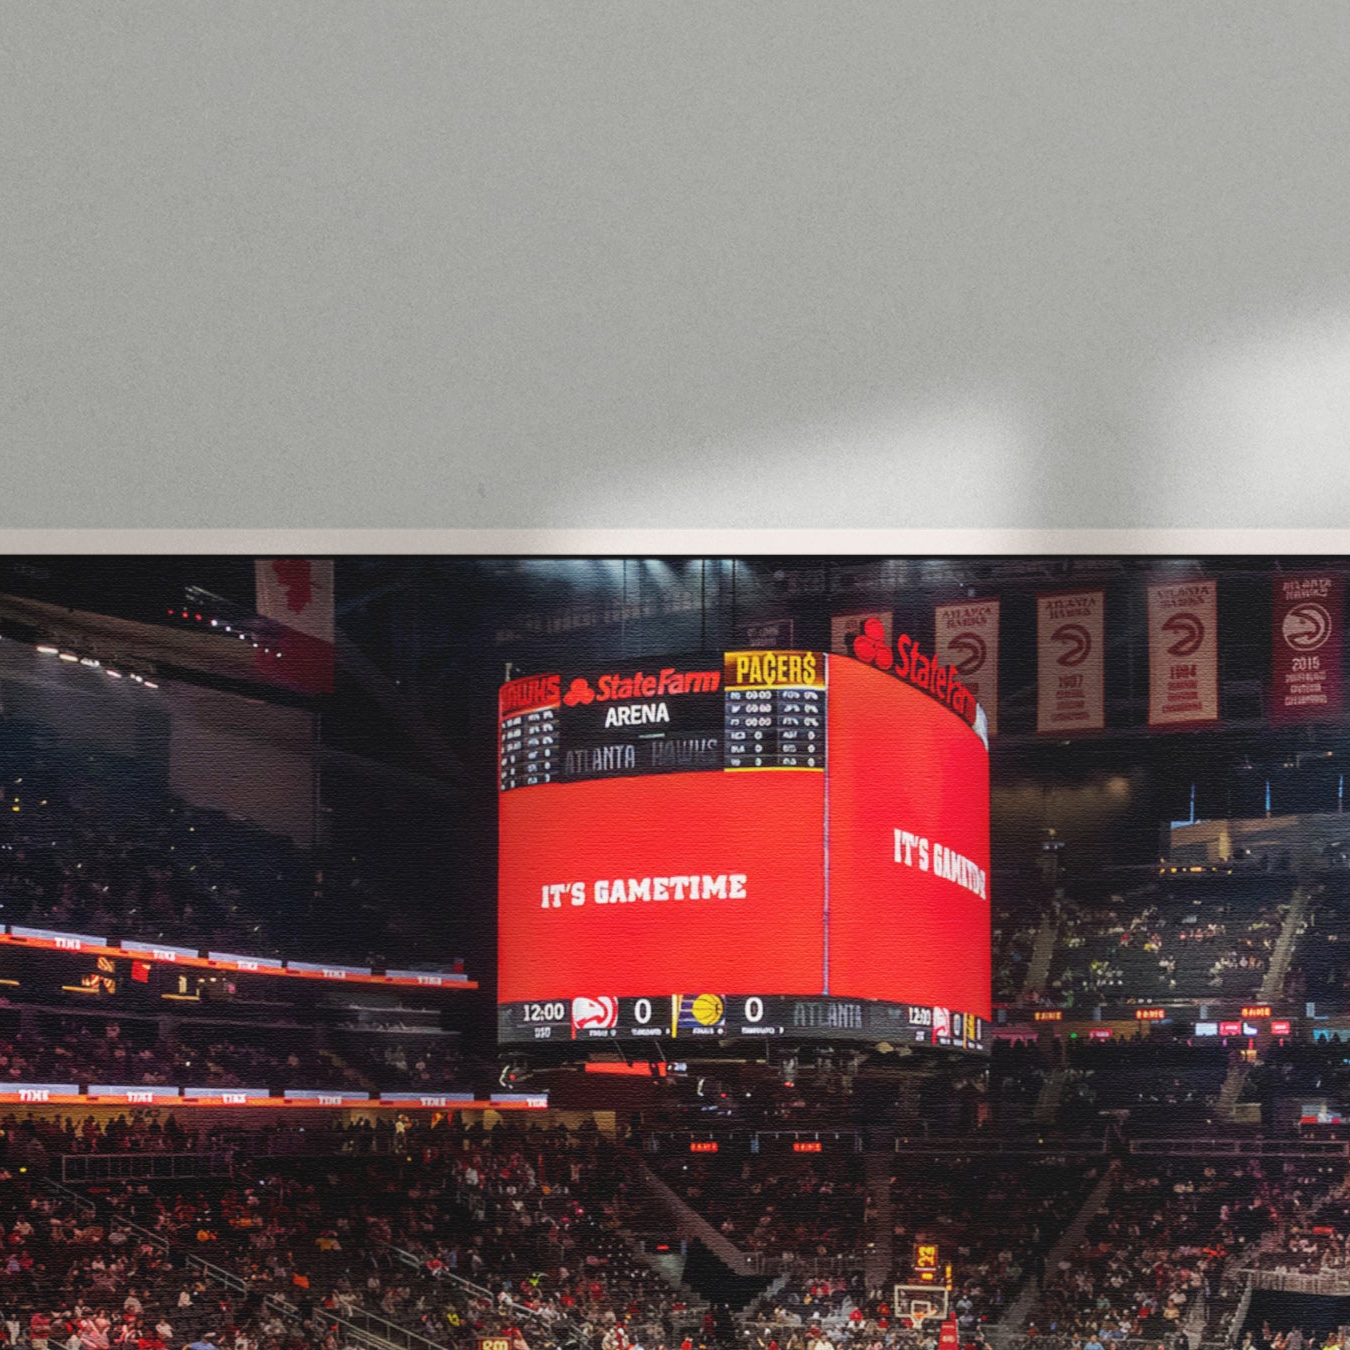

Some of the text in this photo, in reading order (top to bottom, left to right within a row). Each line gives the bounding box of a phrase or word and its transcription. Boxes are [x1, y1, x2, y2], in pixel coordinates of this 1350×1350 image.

[736, 652, 817, 685] PACERS
[604, 702, 671, 729] ARENA
[564, 744, 636, 774] ATLANTA
[893, 829, 929, 871] IT'S
[541, 873, 747, 908] IT'S GAMETIME
[523, 1003, 565, 1022] 12:00
[634, 998, 651, 1023] 0
[745, 997, 763, 1022] 0
